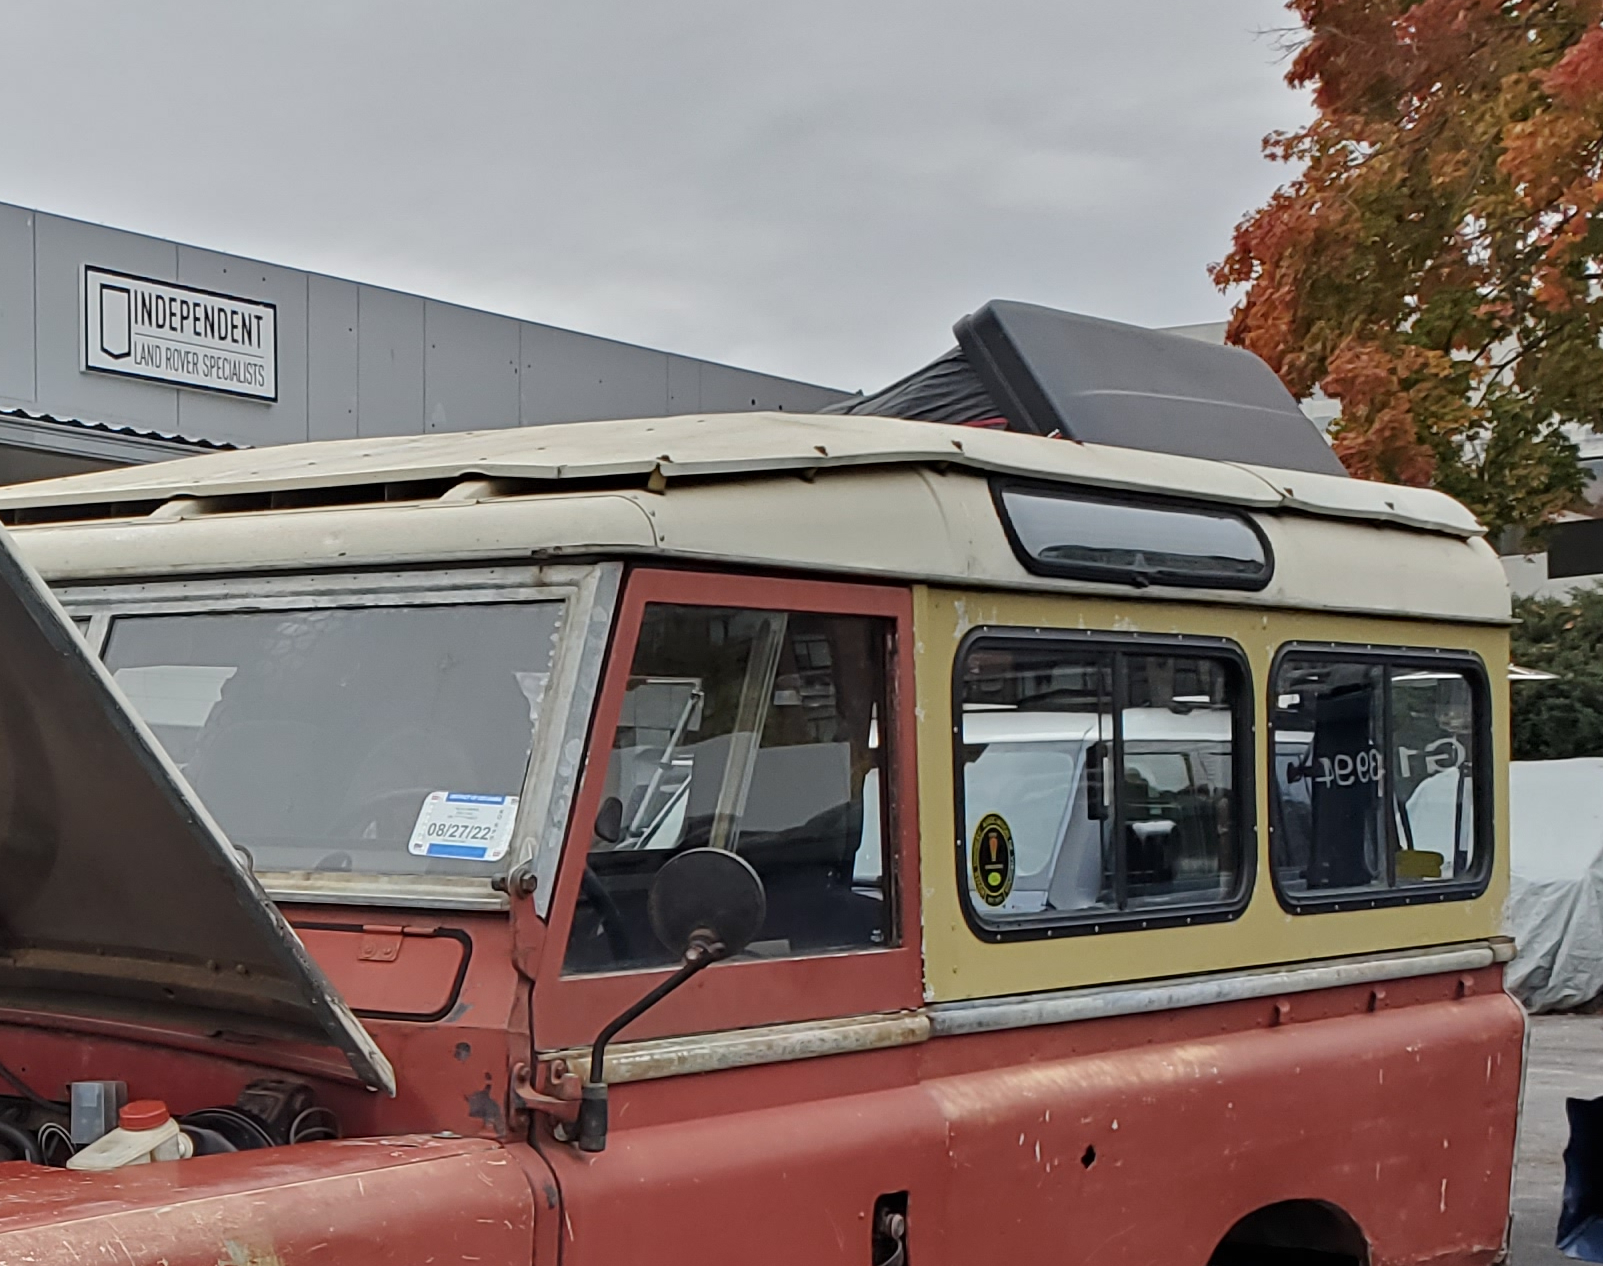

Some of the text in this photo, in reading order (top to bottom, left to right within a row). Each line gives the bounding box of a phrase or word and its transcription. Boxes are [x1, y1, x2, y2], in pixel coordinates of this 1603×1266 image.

[134, 289, 263, 349] INDEPENDENT
[134, 341, 265, 387] LAND ROVER SPECIALISTS
[427, 823, 491, 840] 08/27/22
